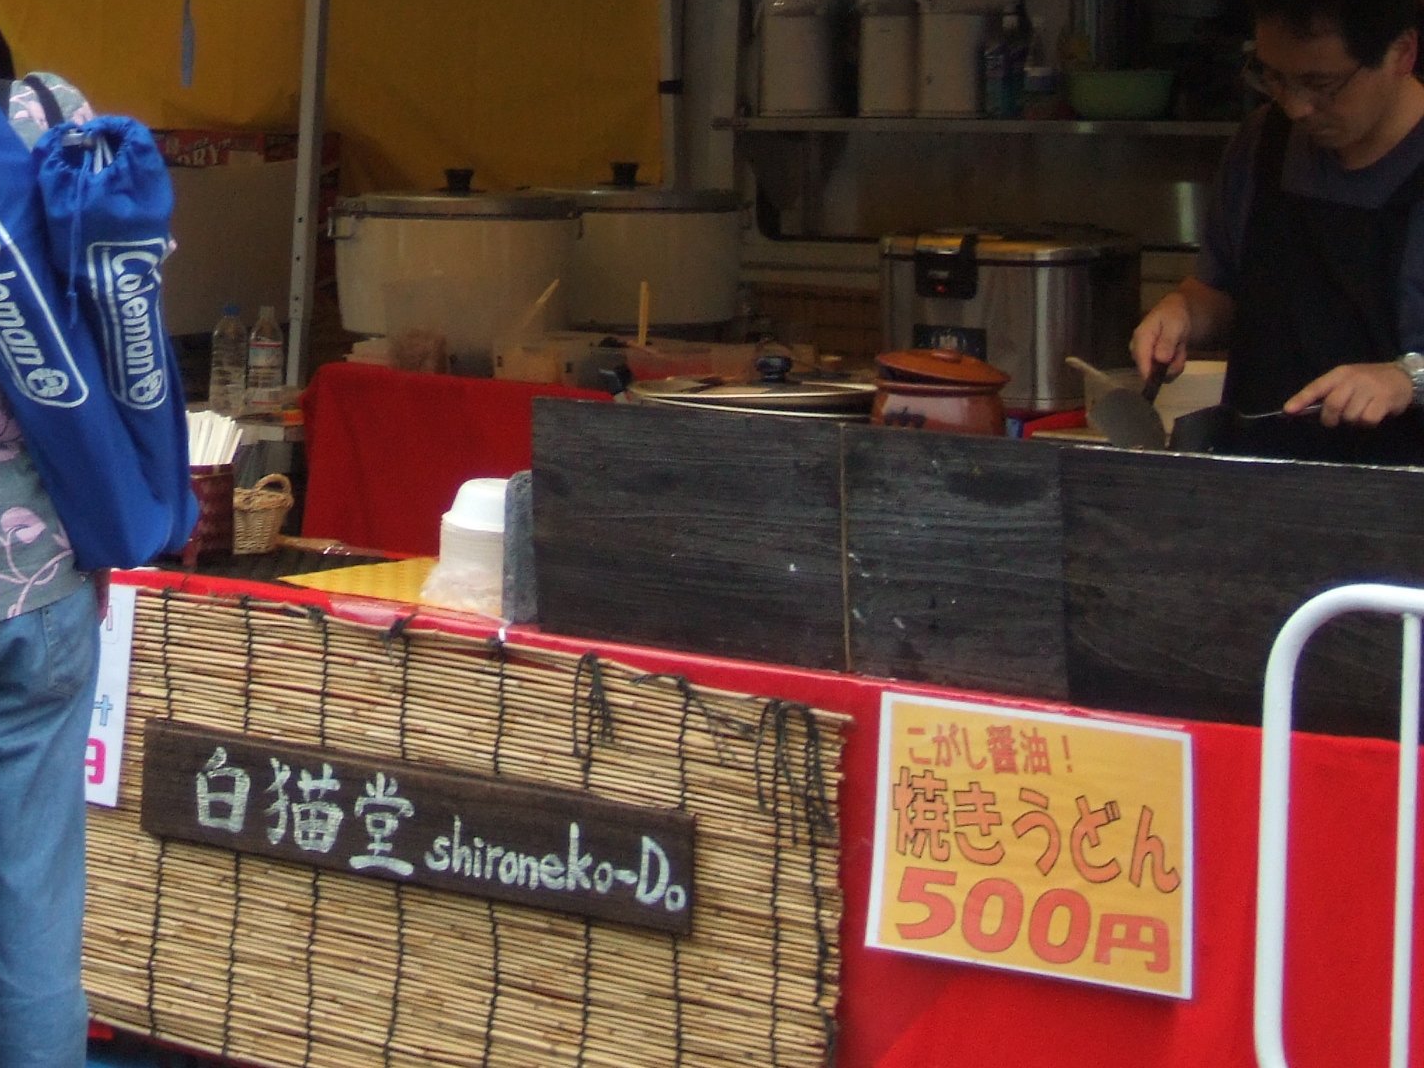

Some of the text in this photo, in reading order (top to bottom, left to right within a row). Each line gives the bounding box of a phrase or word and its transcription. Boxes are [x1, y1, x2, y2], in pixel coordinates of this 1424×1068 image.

[111, 250, 161, 375] Coleman
[195, 745, 416, 877] 白猫堂
[892, 765, 1182, 894] 焼きうどん
[895, 865, 1172, 974] 500円
